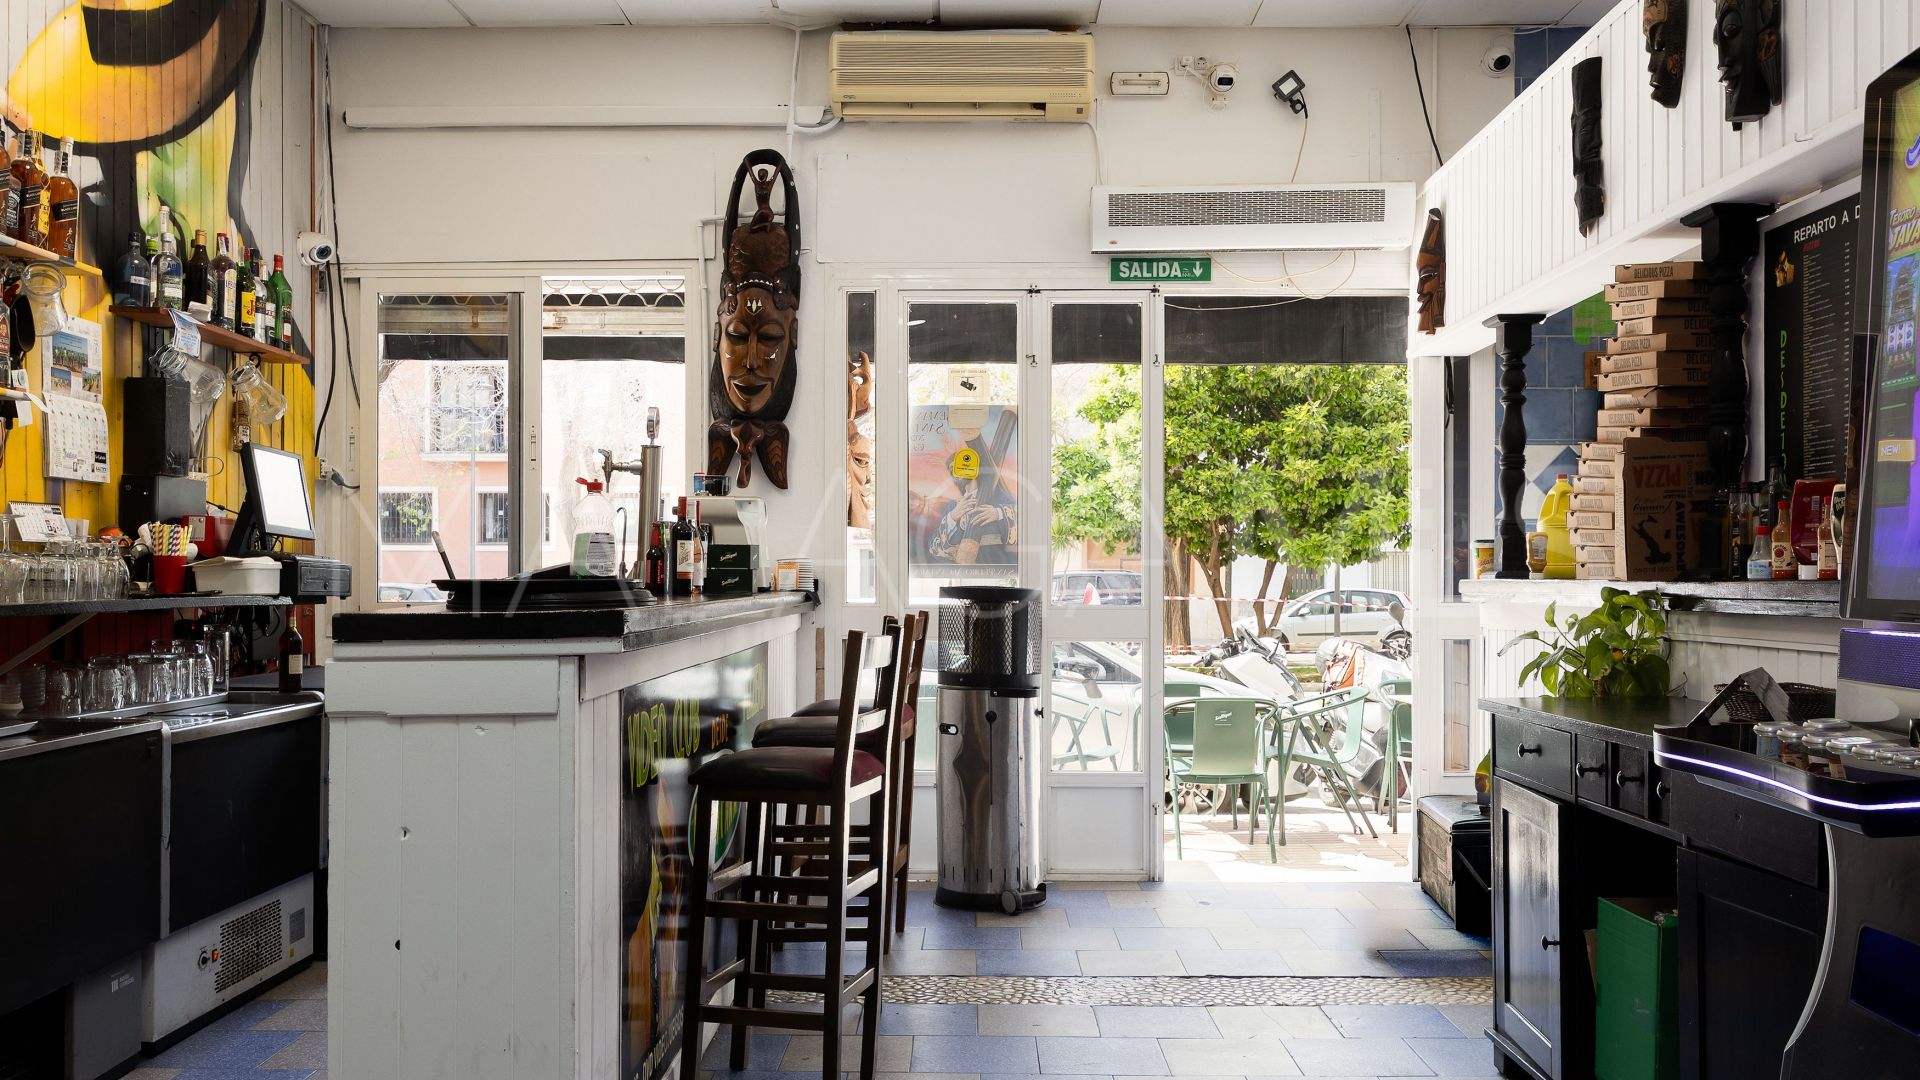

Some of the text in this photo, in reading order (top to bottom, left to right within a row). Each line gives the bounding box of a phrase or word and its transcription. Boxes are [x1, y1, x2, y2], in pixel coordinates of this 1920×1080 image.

[1794, 215, 1837, 244] REPARTO
[1841, 209, 1849, 225] A
[1119, 261, 1182, 278] SALIDA
[1634, 266, 1674, 279] DELICIOUS PIZZA
[1617, 284, 1649, 298] DELICIOUS PIZZA
[1620, 339, 1639, 351] DELICIOUS
[1613, 358, 1630, 370] DELICIOUS
[1611, 375, 1630, 387] DELICIOUS
[1632, 464, 1681, 488] PIZZA
[1676, 501, 1686, 572] AWESOME
[627, 695, 700, 795] VIDEO CLUB
